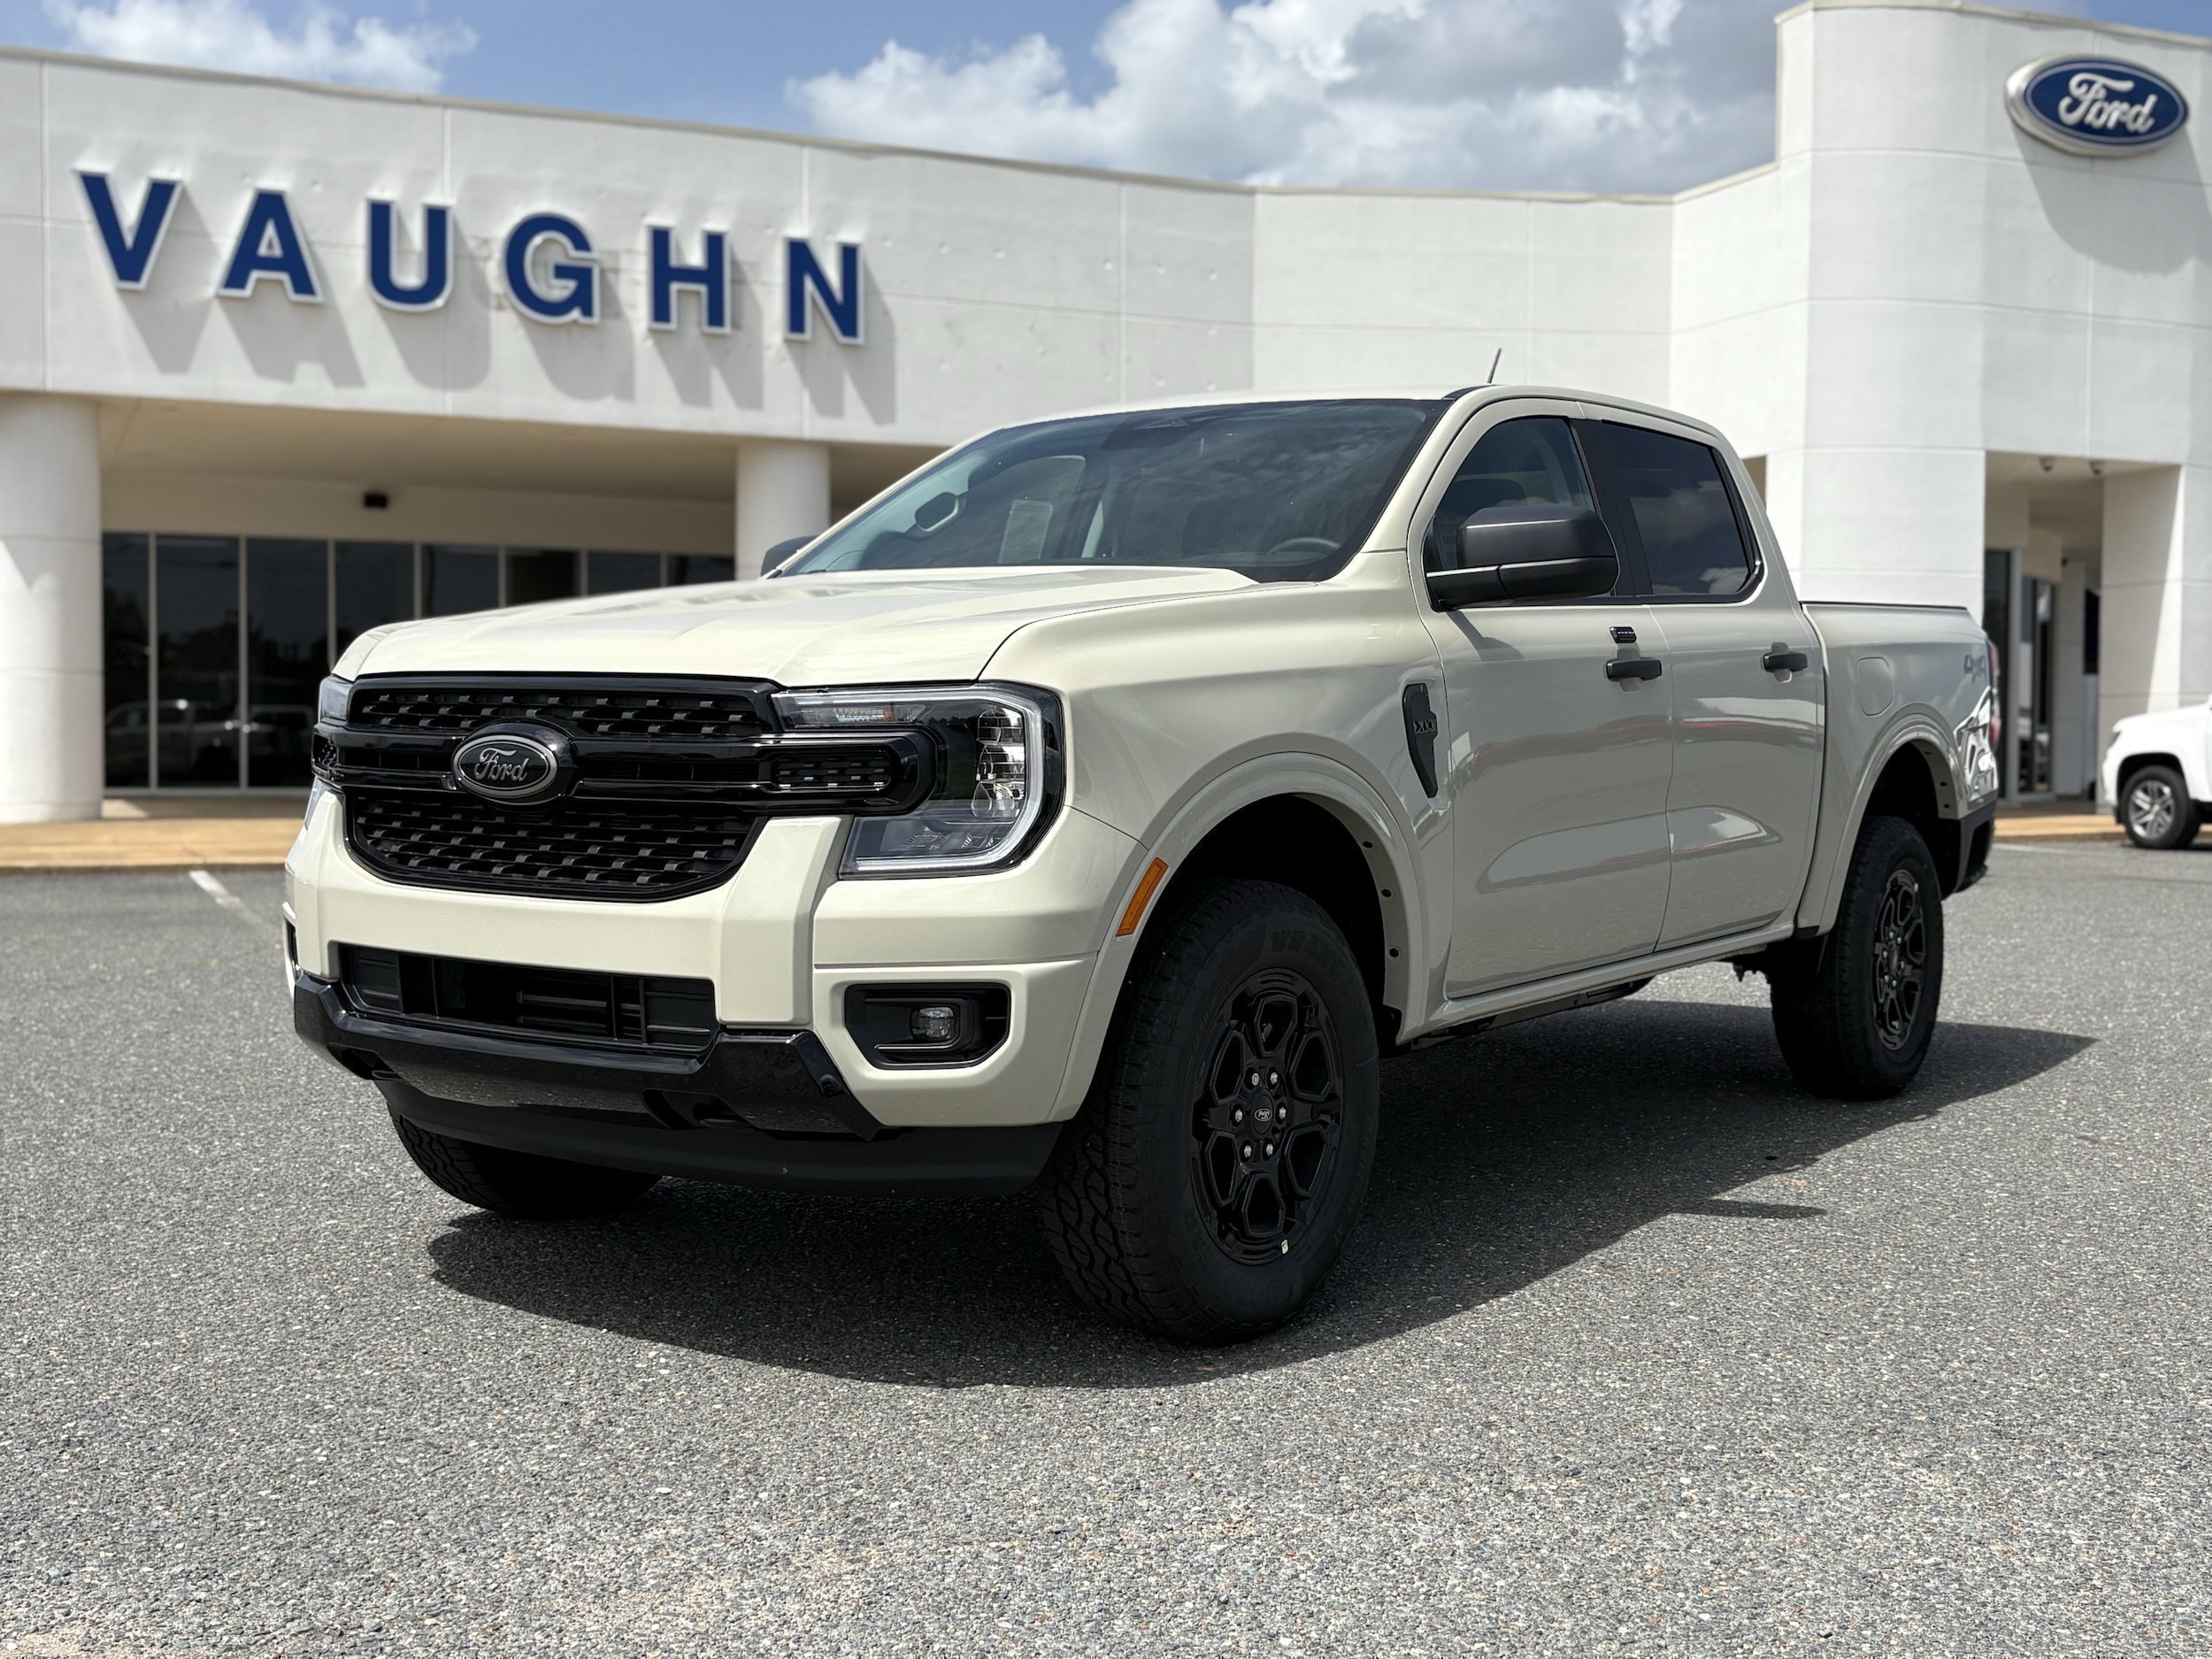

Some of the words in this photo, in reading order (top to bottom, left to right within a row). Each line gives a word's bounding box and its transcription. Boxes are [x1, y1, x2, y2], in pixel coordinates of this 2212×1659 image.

[2058, 73, 2158, 133] Ford
[74, 169, 864, 343] VAUGHN
[473, 747, 530, 782] Ford
